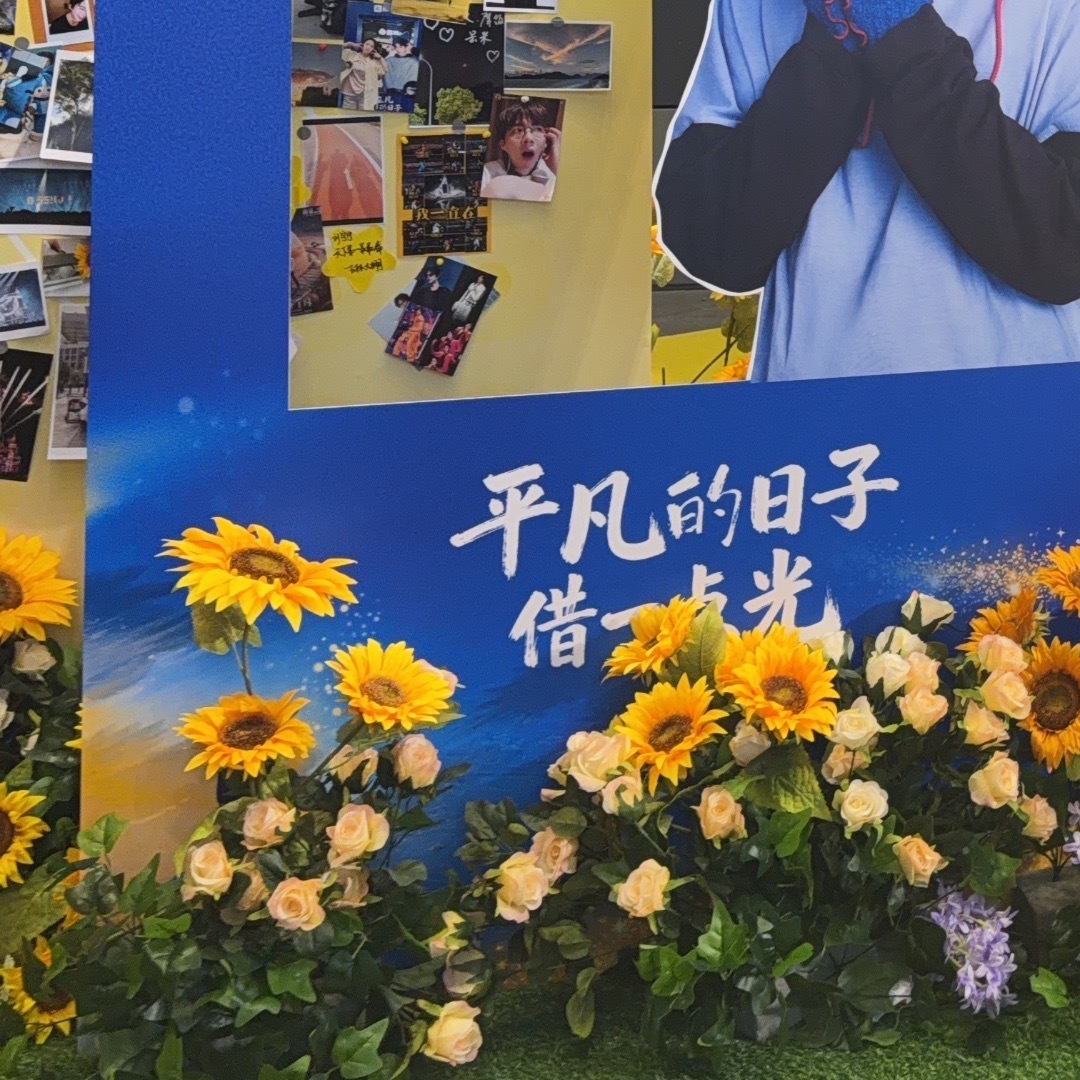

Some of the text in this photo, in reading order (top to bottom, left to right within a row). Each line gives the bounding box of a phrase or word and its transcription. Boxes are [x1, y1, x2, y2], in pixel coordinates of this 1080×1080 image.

[449, 443, 899, 580] 平凡的日子
